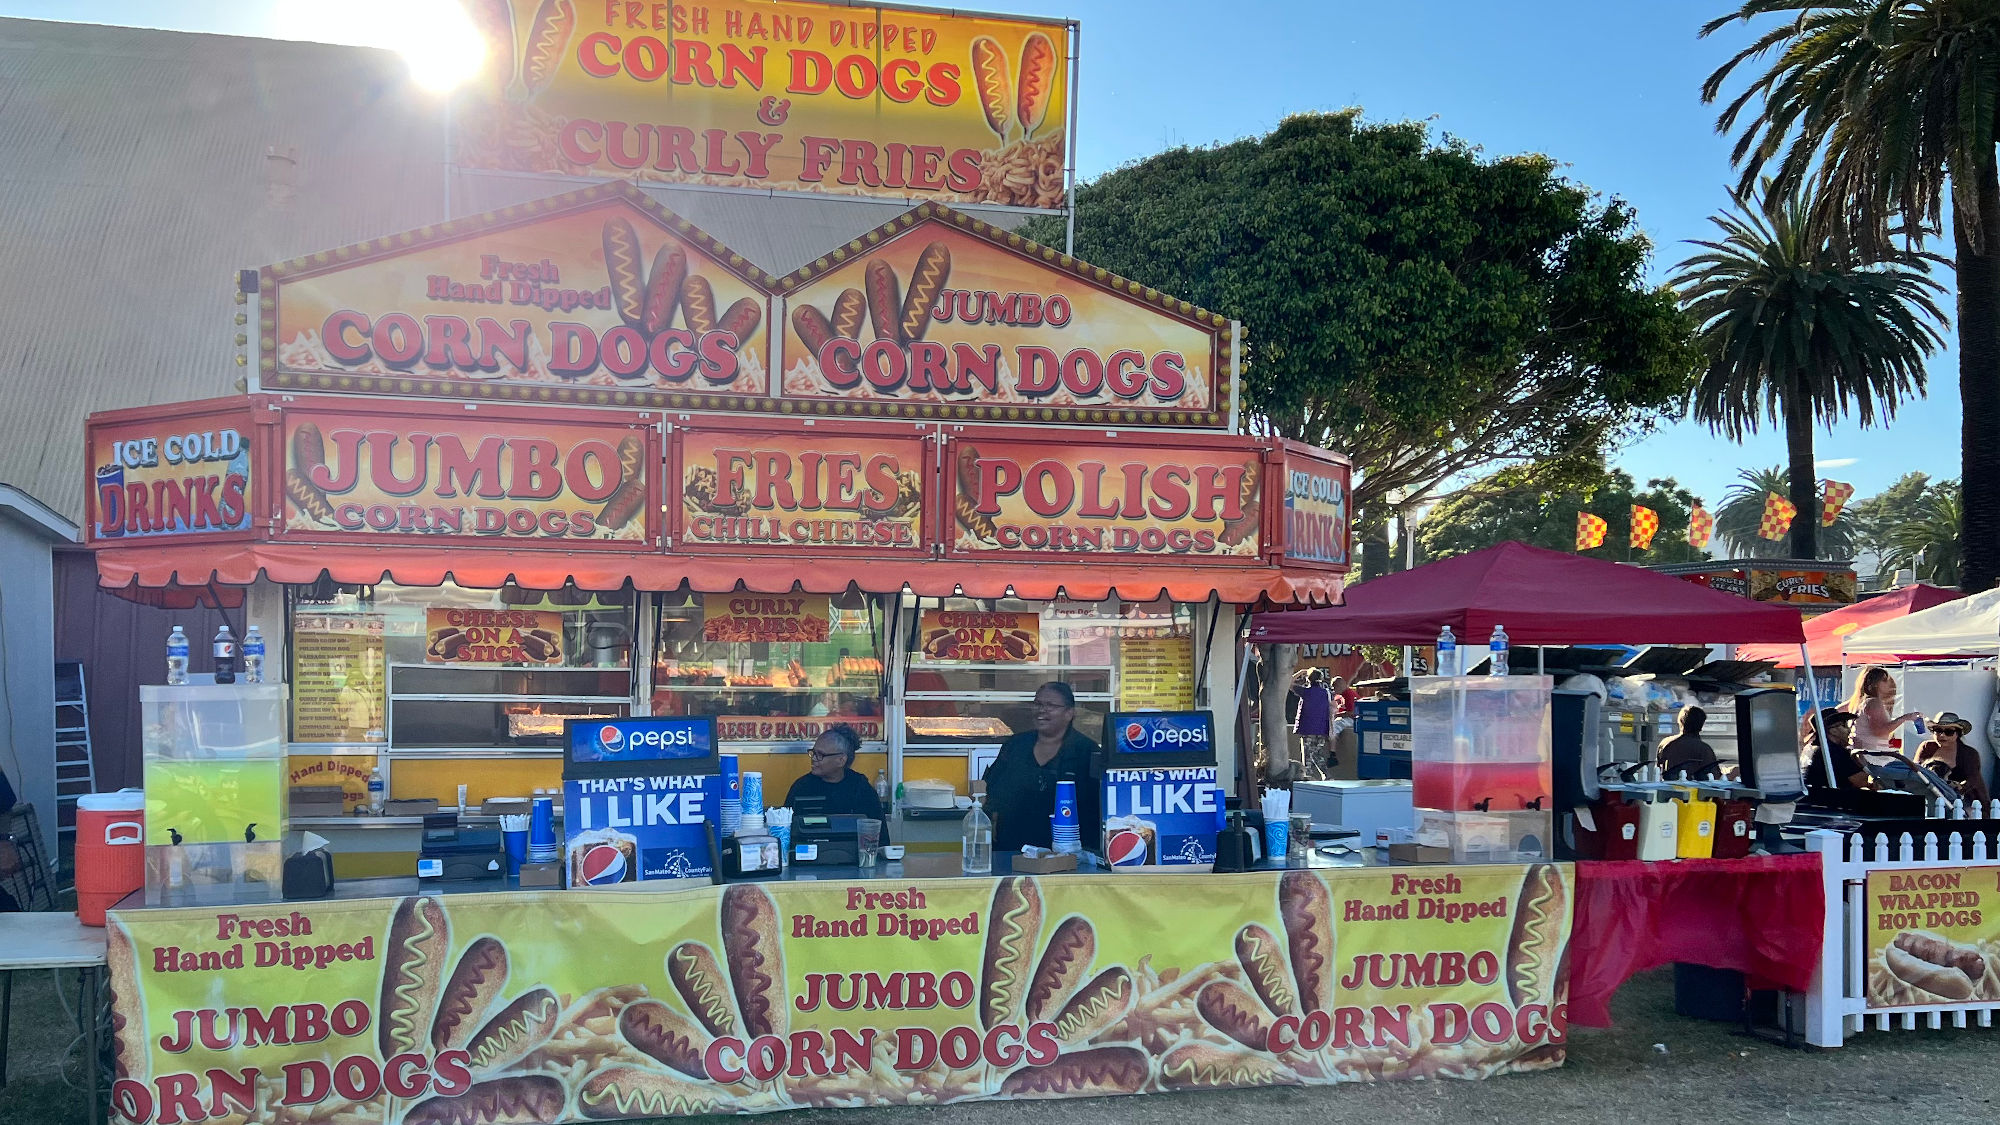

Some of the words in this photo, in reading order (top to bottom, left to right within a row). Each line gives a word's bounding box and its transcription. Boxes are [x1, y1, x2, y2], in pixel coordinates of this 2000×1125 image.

[604, 0, 710, 37] FRESH
[725, 10, 814, 42] HAND
[829, 19, 938, 55] DIPPED
[577, 32, 769, 90] CORN
[787, 49, 961, 106] DOGS
[757, 95, 789, 126] &
[558, 118, 784, 178] CURLY
[799, 135, 984, 192] FRIES
[479, 254, 560, 284] Fresh
[426, 275, 503, 303] Hand
[509, 280, 611, 311] Dipped
[931, 289, 1072, 328] JUMBO
[322, 310, 530, 370] CORN
[547, 321, 740, 385] DOGS
[819, 337, 1000, 394] CORN
[1014, 346, 1187, 401] DOGS
[112, 437, 159, 468] ICE
[163, 428, 241, 465] COLD
[310, 428, 624, 504] JUMBO
[711, 447, 902, 513] FRIES
[974, 457, 1249, 523] POLISH
[1289, 469, 1310, 500] ICE
[1311, 475, 1342, 506] COLD
[100, 473, 245, 534] DRINKS
[334, 503, 463, 534] CORN
[474, 507, 597, 537] DOGS
[690, 516, 782, 542] CHILI
[788, 518, 914, 546] CHEESE
[1285, 507, 1344, 561] DRINKS
[995, 523, 1103, 551] CORN
[1112, 526, 1216, 554] DOGS
[1776, 576, 1805, 592] CURLY
[1788, 584, 1830, 598] FRIES
[446, 609, 539, 628] CHEESE
[728, 598, 805, 616] CURLY
[938, 611, 1019, 629] CHEESE
[465, 627, 502, 644] ON
[505, 627, 524, 644] A
[730, 617, 801, 634] FRIES
[954, 628, 990, 645] ON
[990, 629, 1007, 645] A
[456, 645, 528, 664] STICK
[946, 644, 1010, 661] STICK
[629, 726, 693, 751] pepsi
[759, 722, 773, 737] &
[774, 721, 822, 738] HAND
[1152, 725, 1208, 748] pepsi
[290, 761, 324, 784] Hand
[327, 760, 371, 783] Dipped
[578, 777, 646, 794] THAT'S
[649, 775, 706, 791] WHAT
[1106, 769, 1165, 783] THAT'S
[1168, 767, 1217, 781] WHAT
[580, 797, 592, 830] I
[607, 792, 706, 828] LIKE
[1107, 785, 1117, 816] I
[1131, 782, 1218, 815] LIKE
[1390, 873, 1462, 896] Fresh
[1889, 872, 1962, 892] BACON
[845, 885, 928, 912] Fresh
[1342, 900, 1413, 924] Hand
[1416, 895, 1508, 924] Dipped
[1877, 891, 1981, 911] WRAPPED
[215, 911, 314, 941] Fresh
[790, 914, 872, 940] Hand
[876, 910, 981, 942] Dipped
[1877, 912, 1921, 931] HOT
[1926, 910, 1983, 929] DOGS
[152, 943, 245, 973] Hand
[254, 935, 376, 972] Dipped
[1340, 949, 1501, 992] JUMBO
[794, 969, 977, 1014] JUMBO
[158, 998, 373, 1055] JUMBO
[1264, 1002, 1413, 1057] CORN
[1427, 1001, 1568, 1048] DOGS
[702, 1026, 879, 1085] CORN
[892, 1021, 1061, 1071] DOGS
[107, 1066, 262, 1125] ORN
[280, 1048, 475, 1107] DOGS
